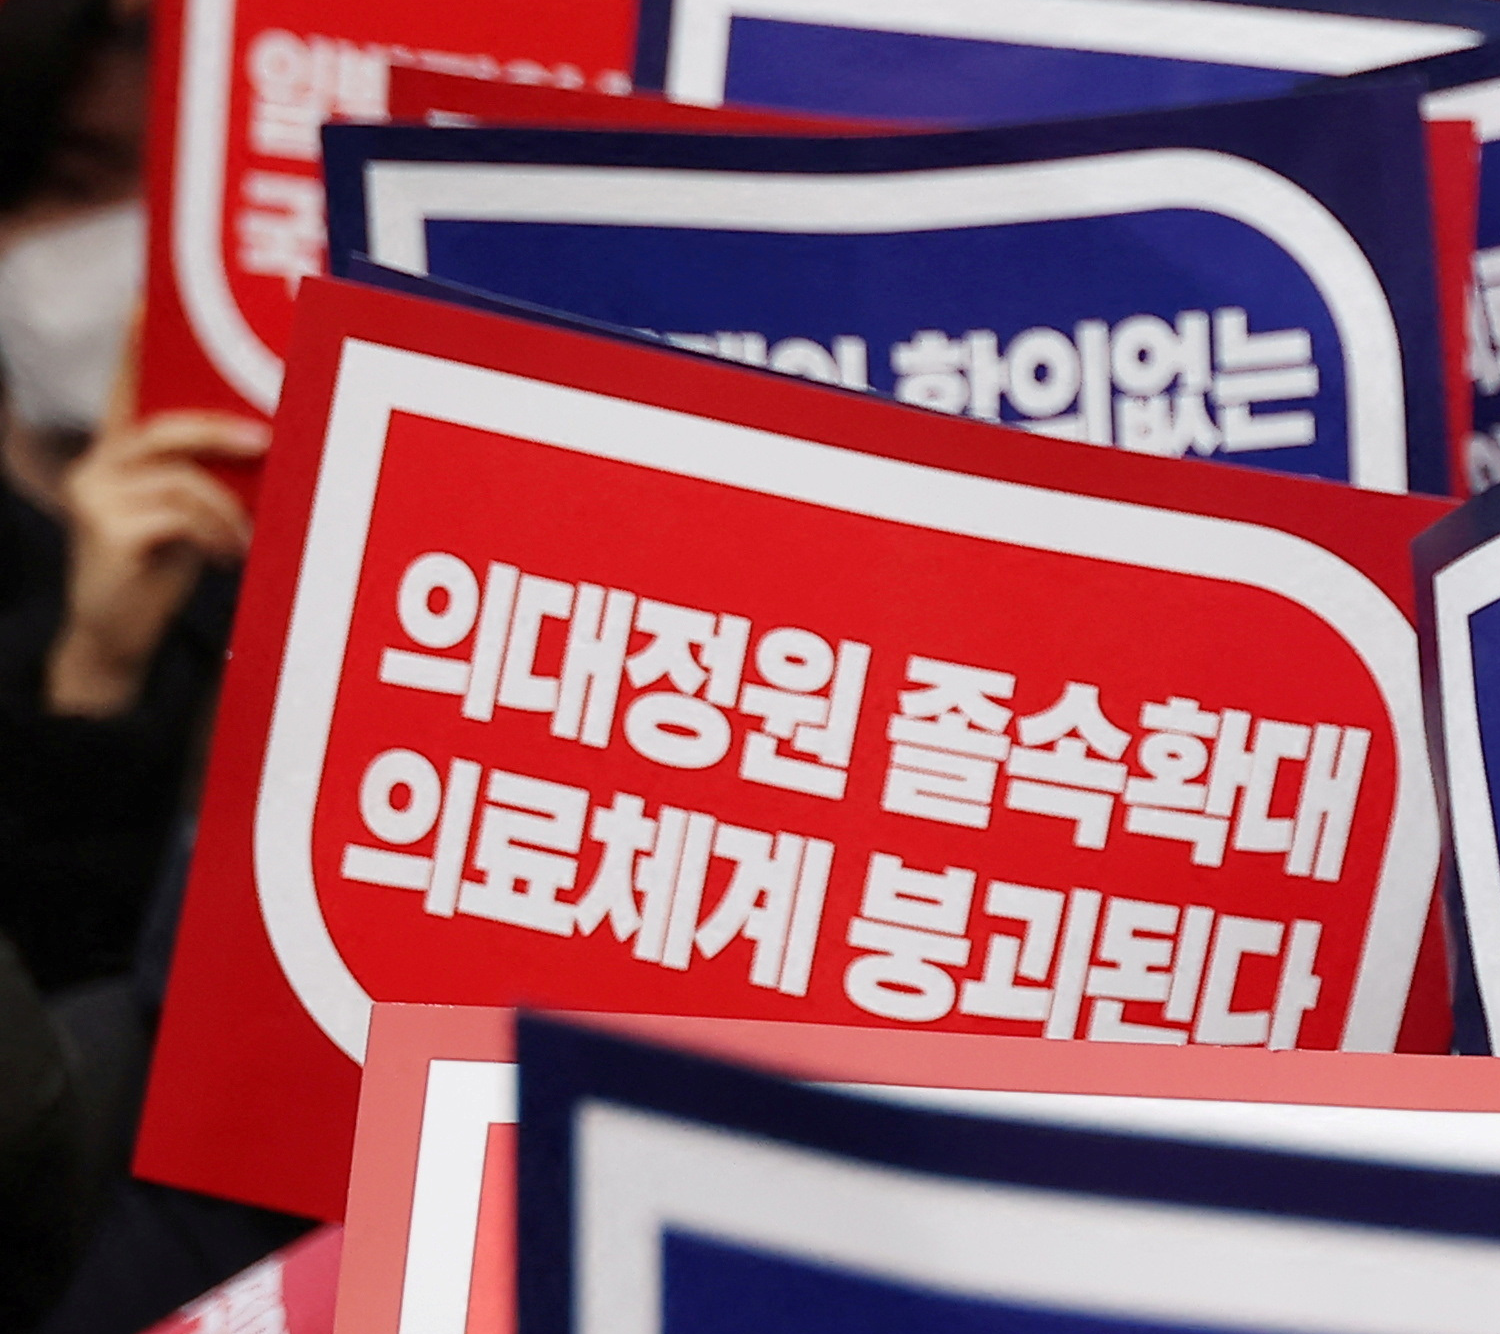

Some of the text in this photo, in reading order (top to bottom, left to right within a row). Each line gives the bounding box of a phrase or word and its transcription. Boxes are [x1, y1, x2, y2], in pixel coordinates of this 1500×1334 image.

[380, 549, 1372, 884] 의대정원 졸속확대
[340, 746, 1323, 1053] 의료체계 붕괴된다
